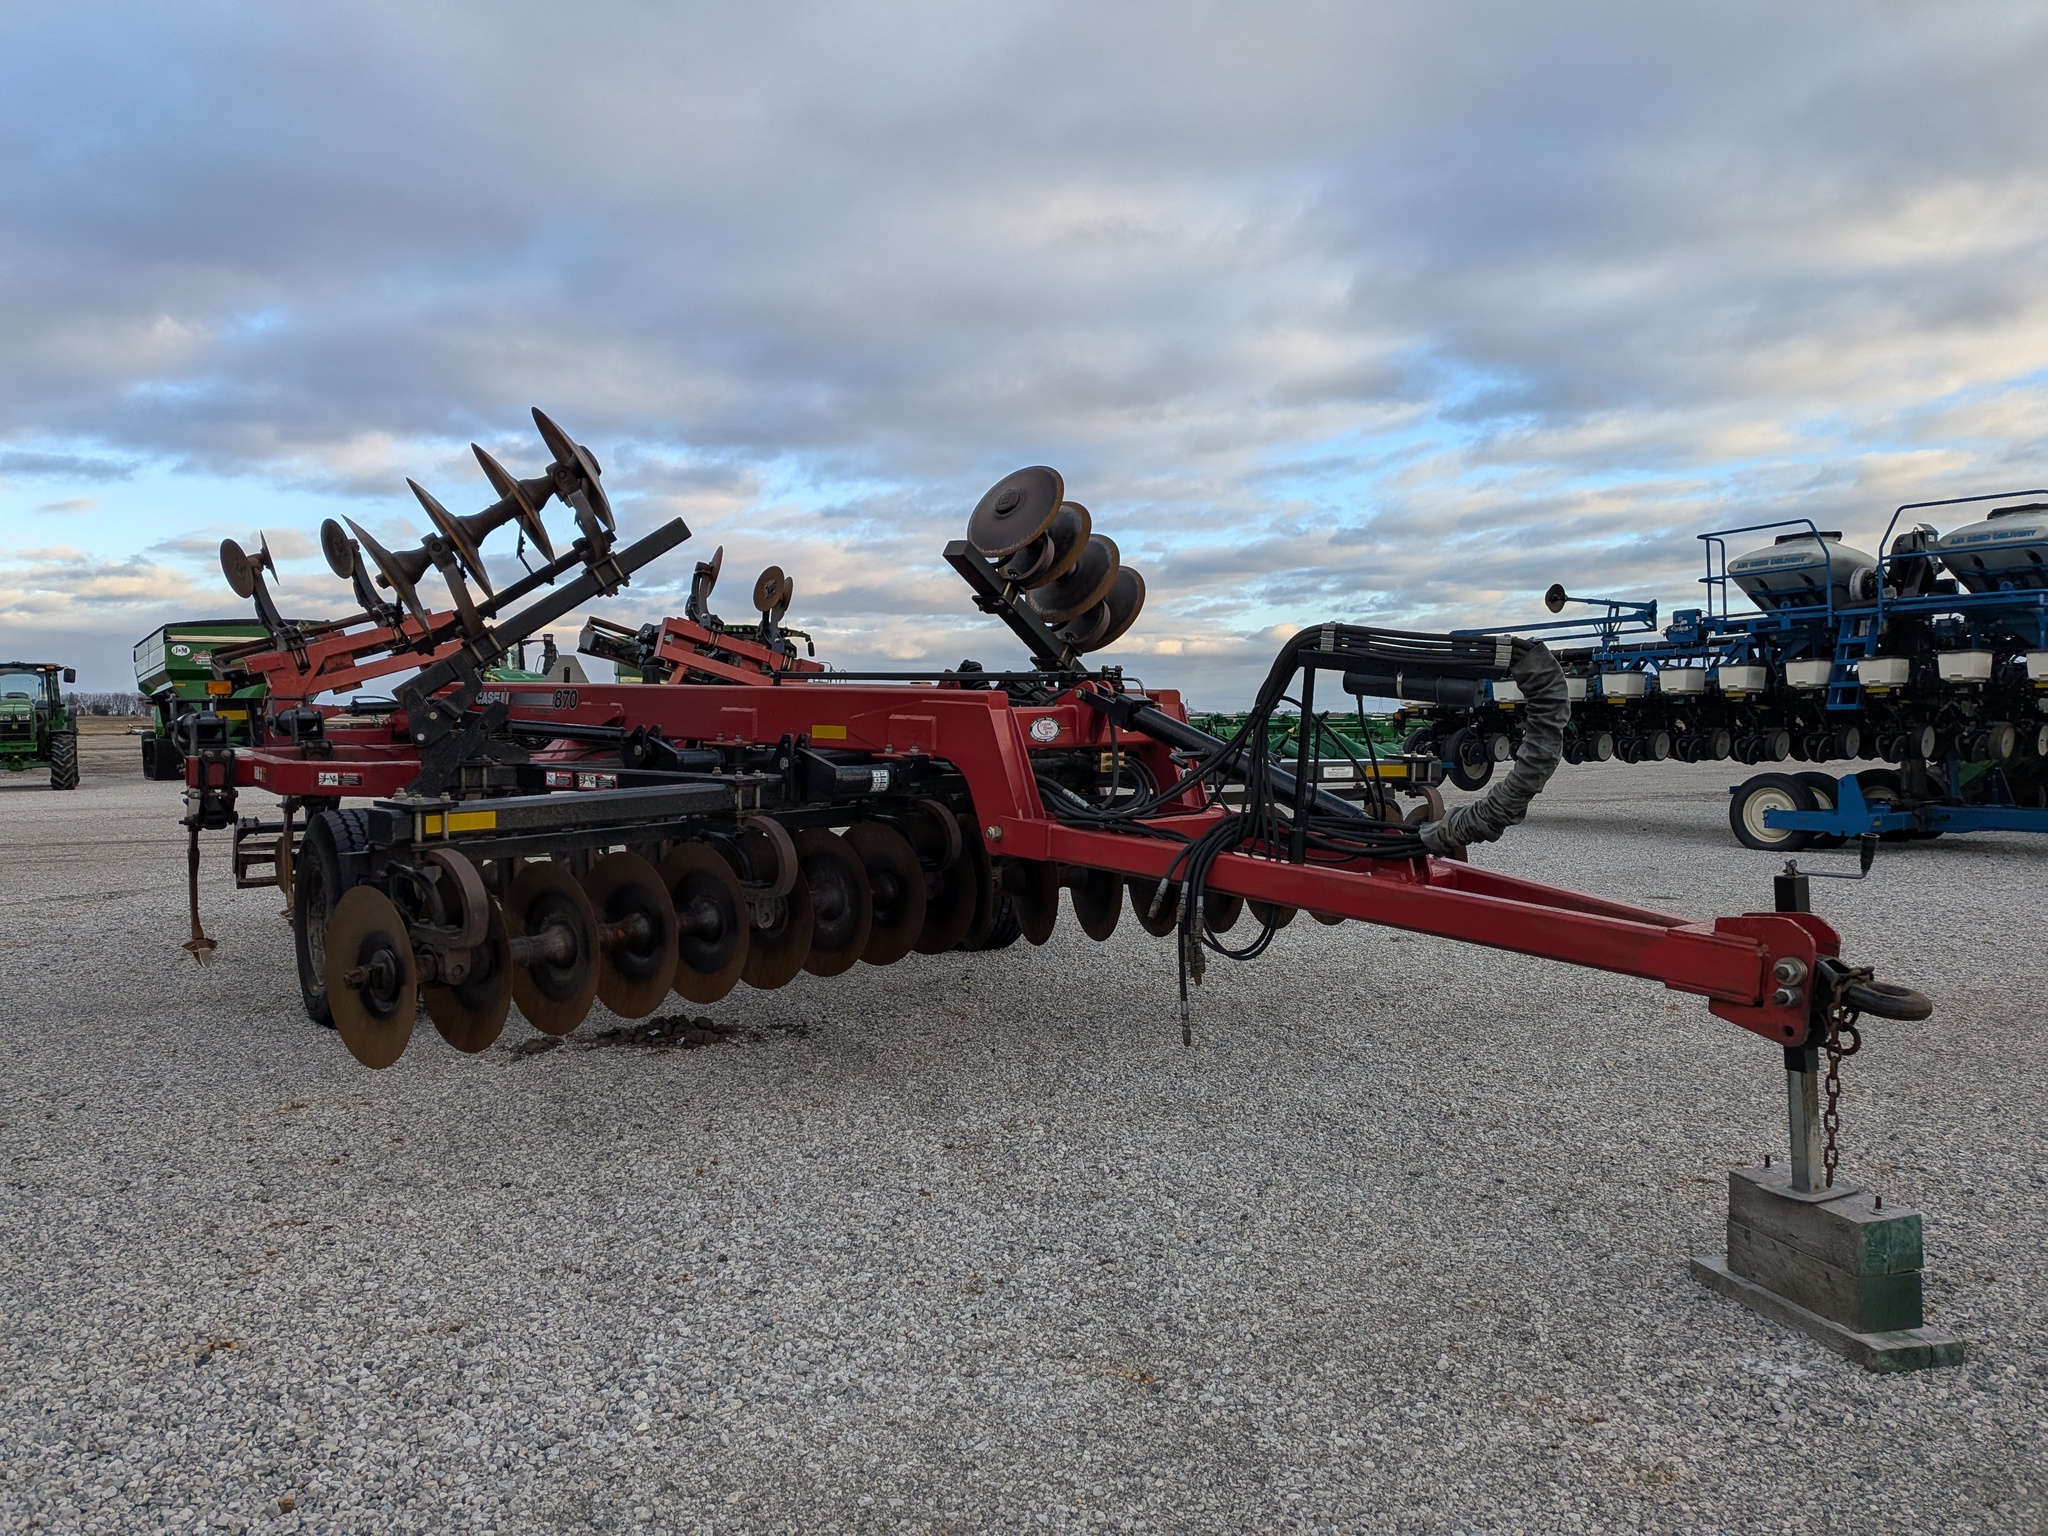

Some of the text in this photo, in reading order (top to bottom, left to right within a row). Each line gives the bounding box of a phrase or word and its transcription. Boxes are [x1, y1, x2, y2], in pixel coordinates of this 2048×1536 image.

[1992, 529, 2038, 540] DELIVERY
[1770, 555, 1807, 565] DELIVERY
[475, 691, 501, 705] CASE
[554, 688, 578, 711] 870
